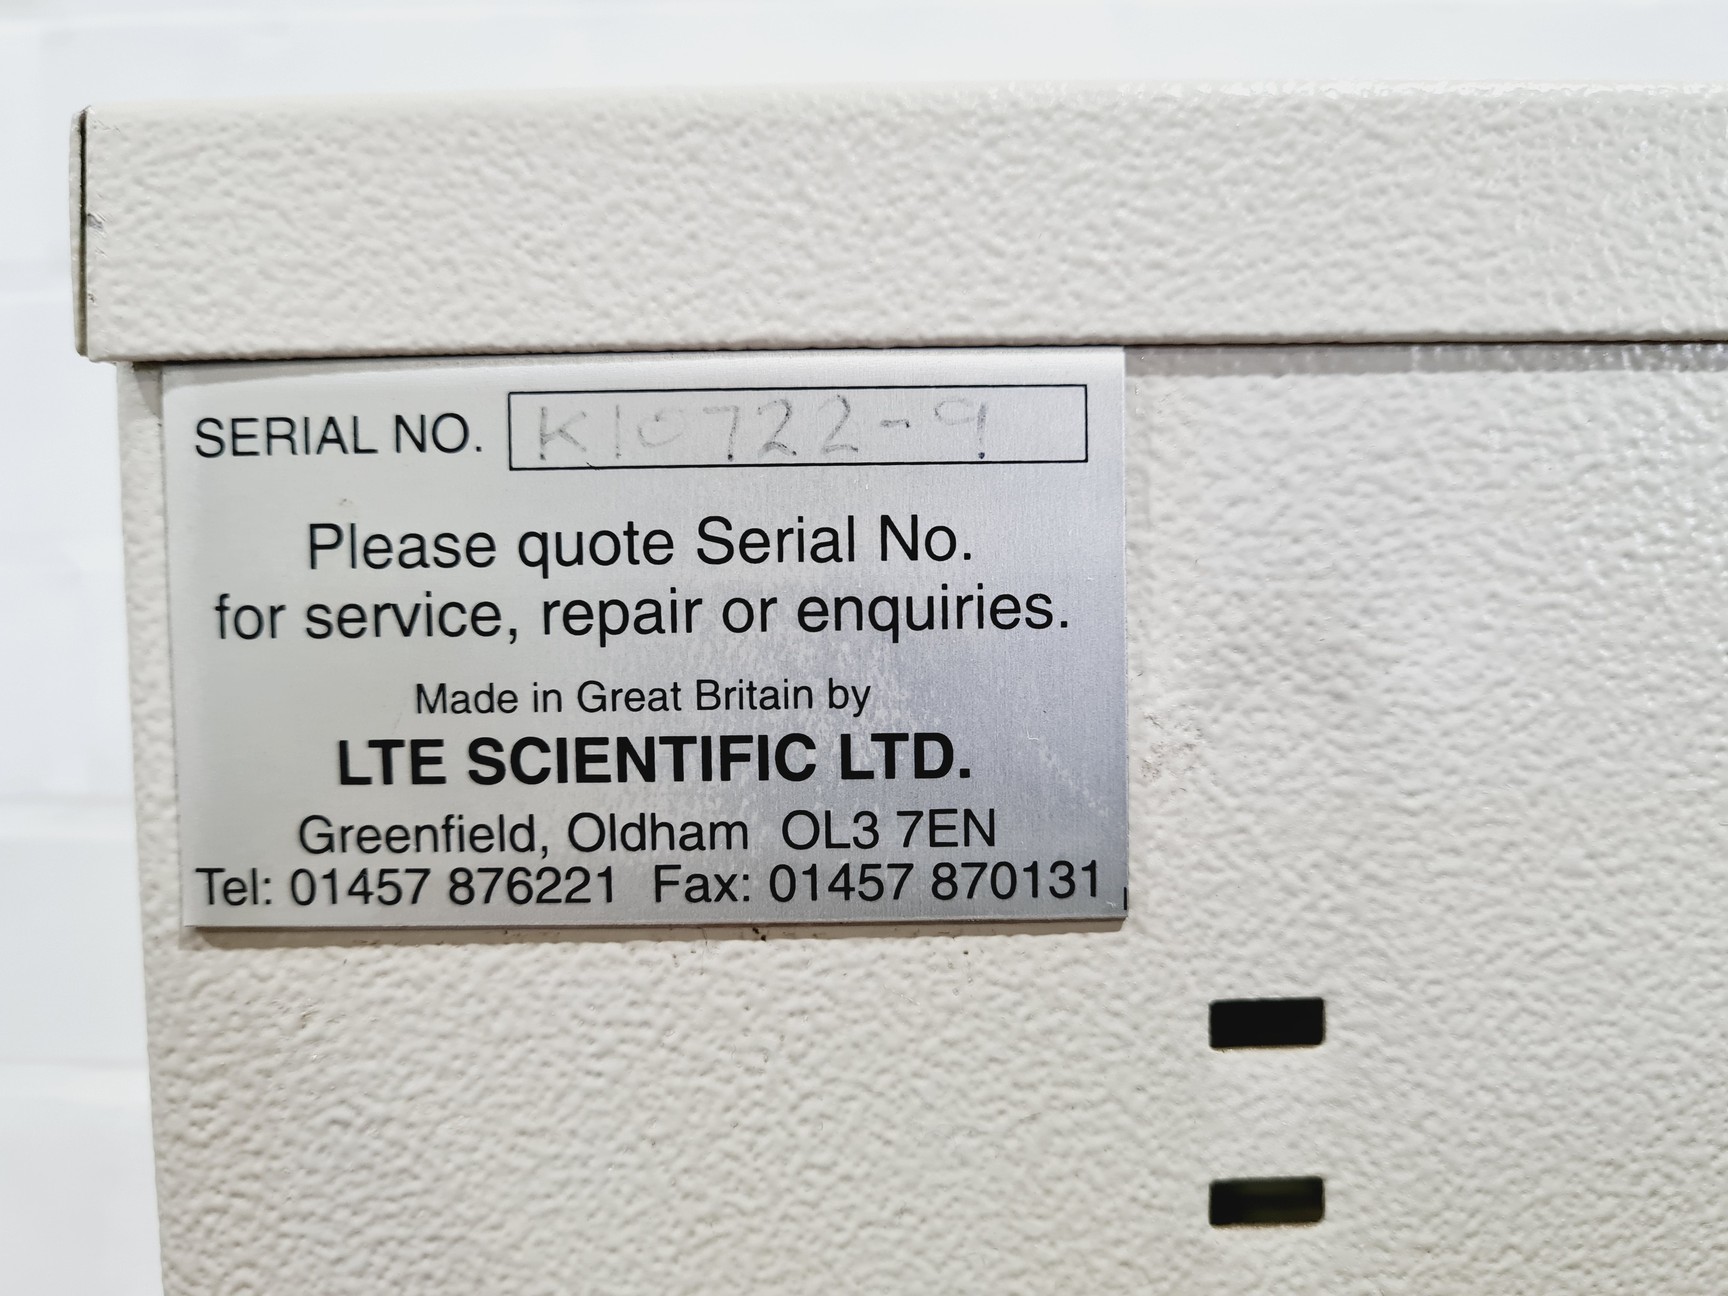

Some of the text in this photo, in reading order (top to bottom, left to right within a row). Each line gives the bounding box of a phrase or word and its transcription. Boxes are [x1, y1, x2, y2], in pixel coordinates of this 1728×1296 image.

[195, 412, 482, 459] SERIAL NO.
[309, 513, 972, 580] Please quote Serial No.
[214, 582, 1068, 648] for service, repair or enquiries.
[415, 677, 872, 718] Made in Great Britain by
[338, 732, 971, 786] LTE SCIENTIFIC LTD.
[298, 807, 996, 860] Greenfield, Oldham OL3 7EN
[194, 859, 1098, 907] Tel: 01457 876221 Fax: 01457 870131
